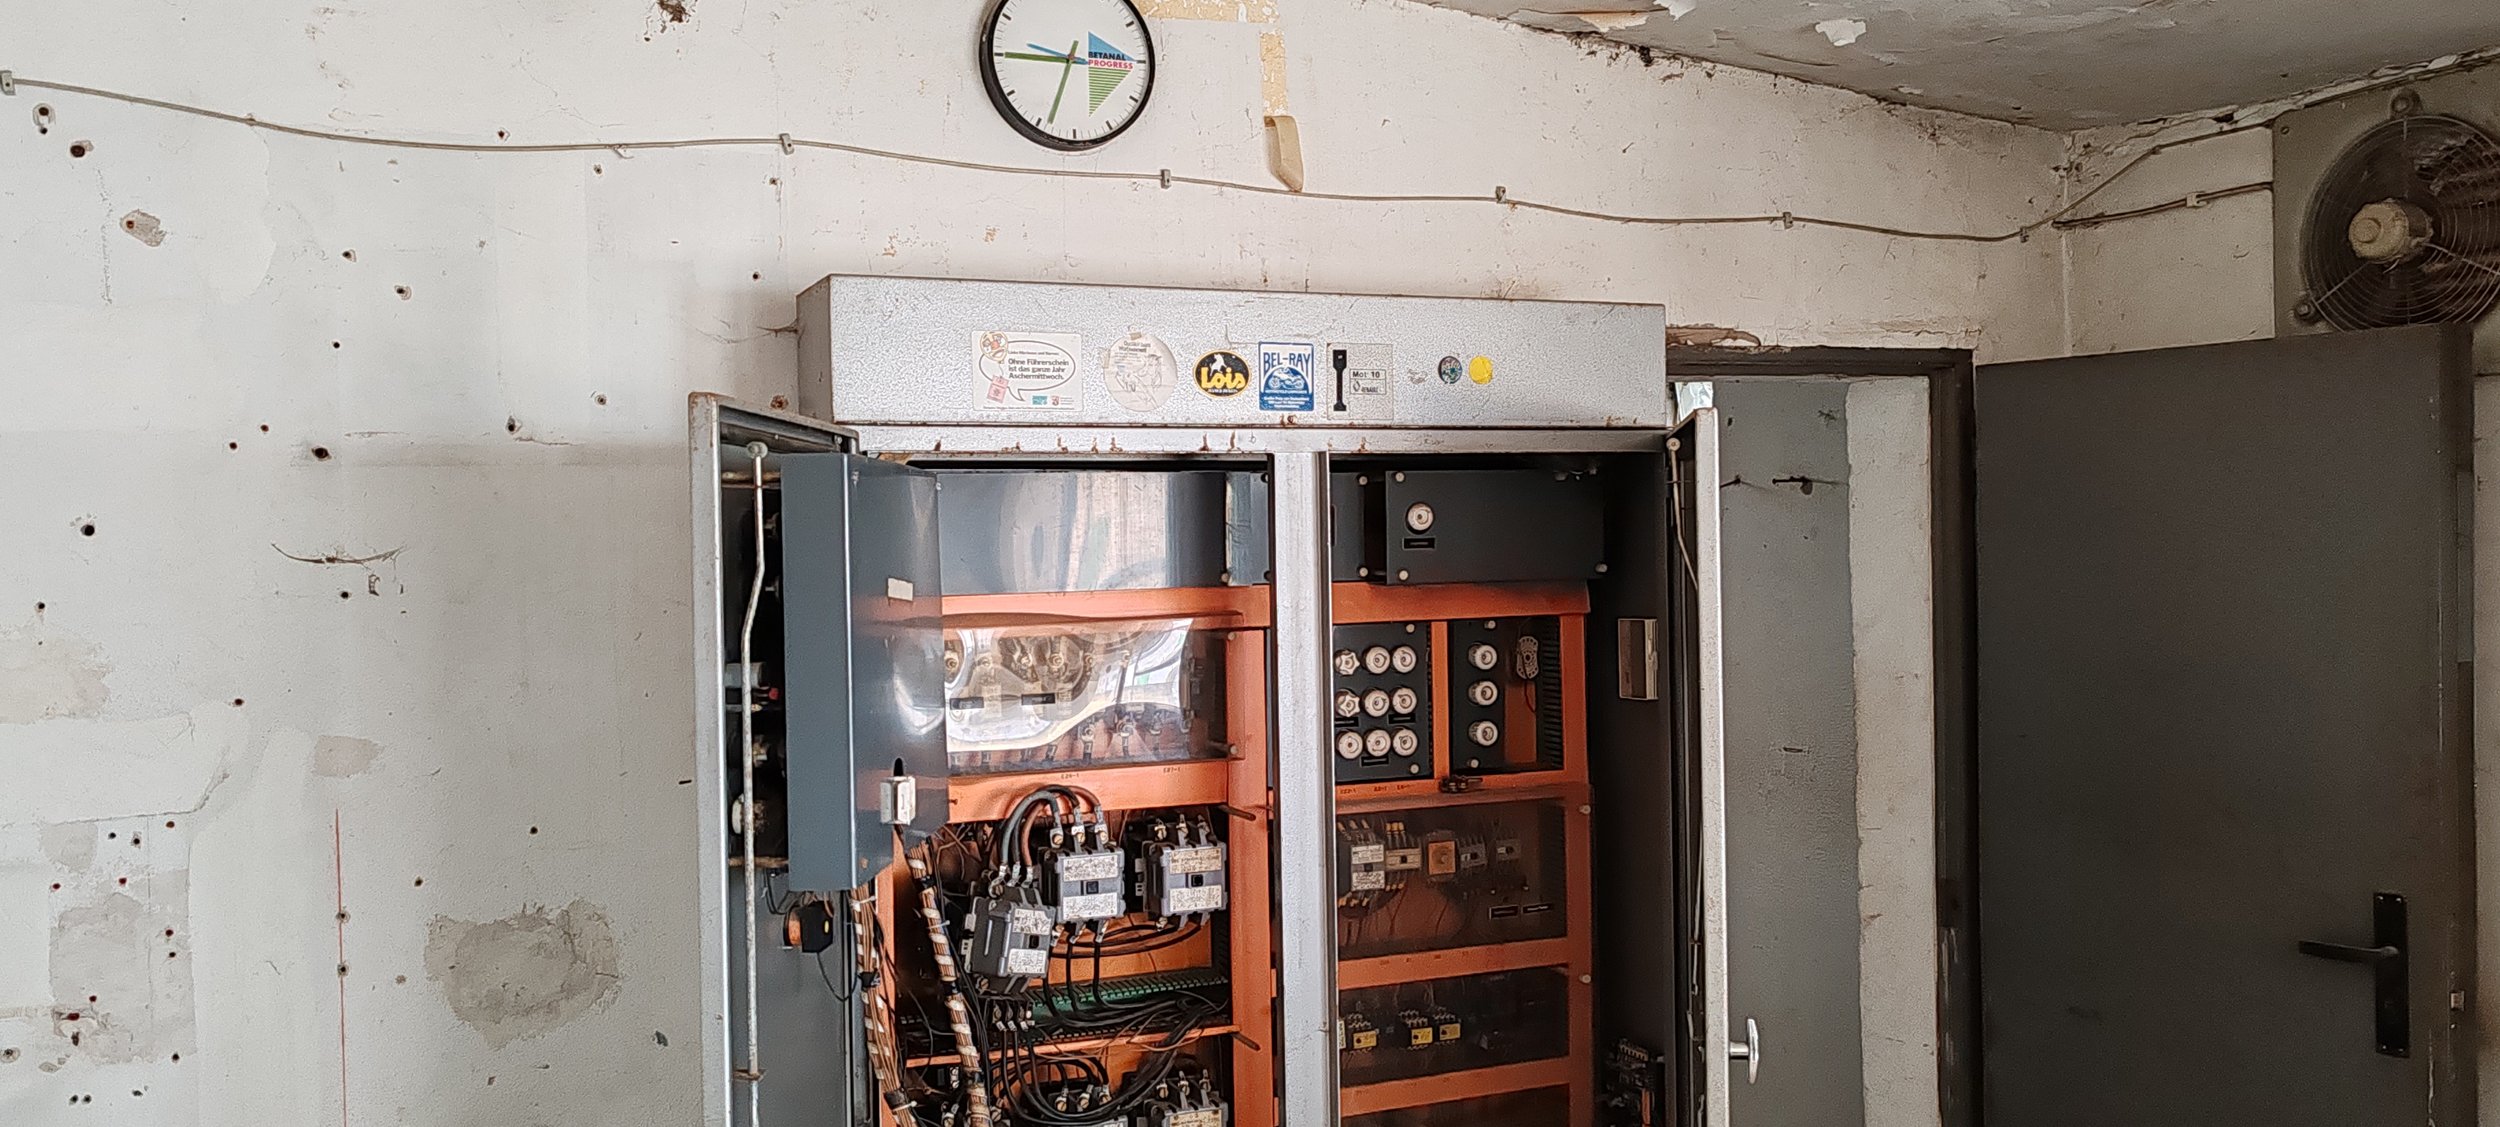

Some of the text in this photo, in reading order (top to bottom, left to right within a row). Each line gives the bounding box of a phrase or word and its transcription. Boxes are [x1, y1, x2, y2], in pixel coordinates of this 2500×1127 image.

[1088, 52, 1126, 61] BETANAL
[1088, 59, 1133, 69] PROGRESS
[1027, 358, 1069, 366] Führerschein
[1263, 352, 1311, 378] BEL-RAY
[1201, 367, 1246, 389] Lois
